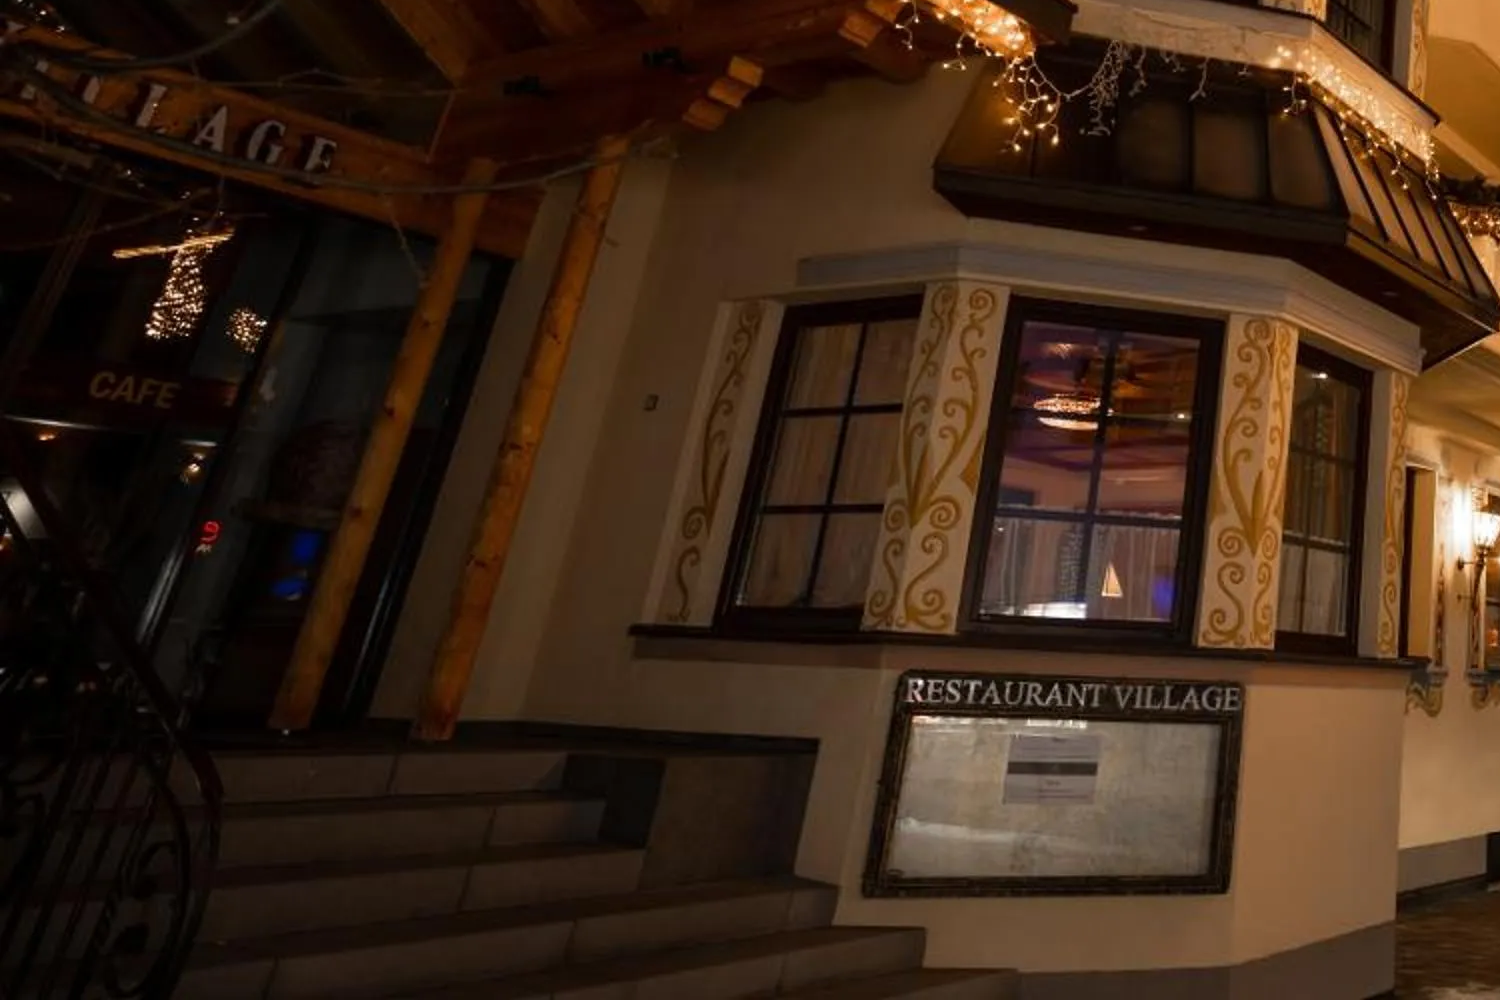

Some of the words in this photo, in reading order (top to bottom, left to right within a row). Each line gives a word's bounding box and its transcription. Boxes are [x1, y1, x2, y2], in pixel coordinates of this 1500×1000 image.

[88, 369, 183, 409] CAFE
[906, 677, 1107, 708] RESTAURANT
[1114, 685, 1241, 711] VILLAGE
